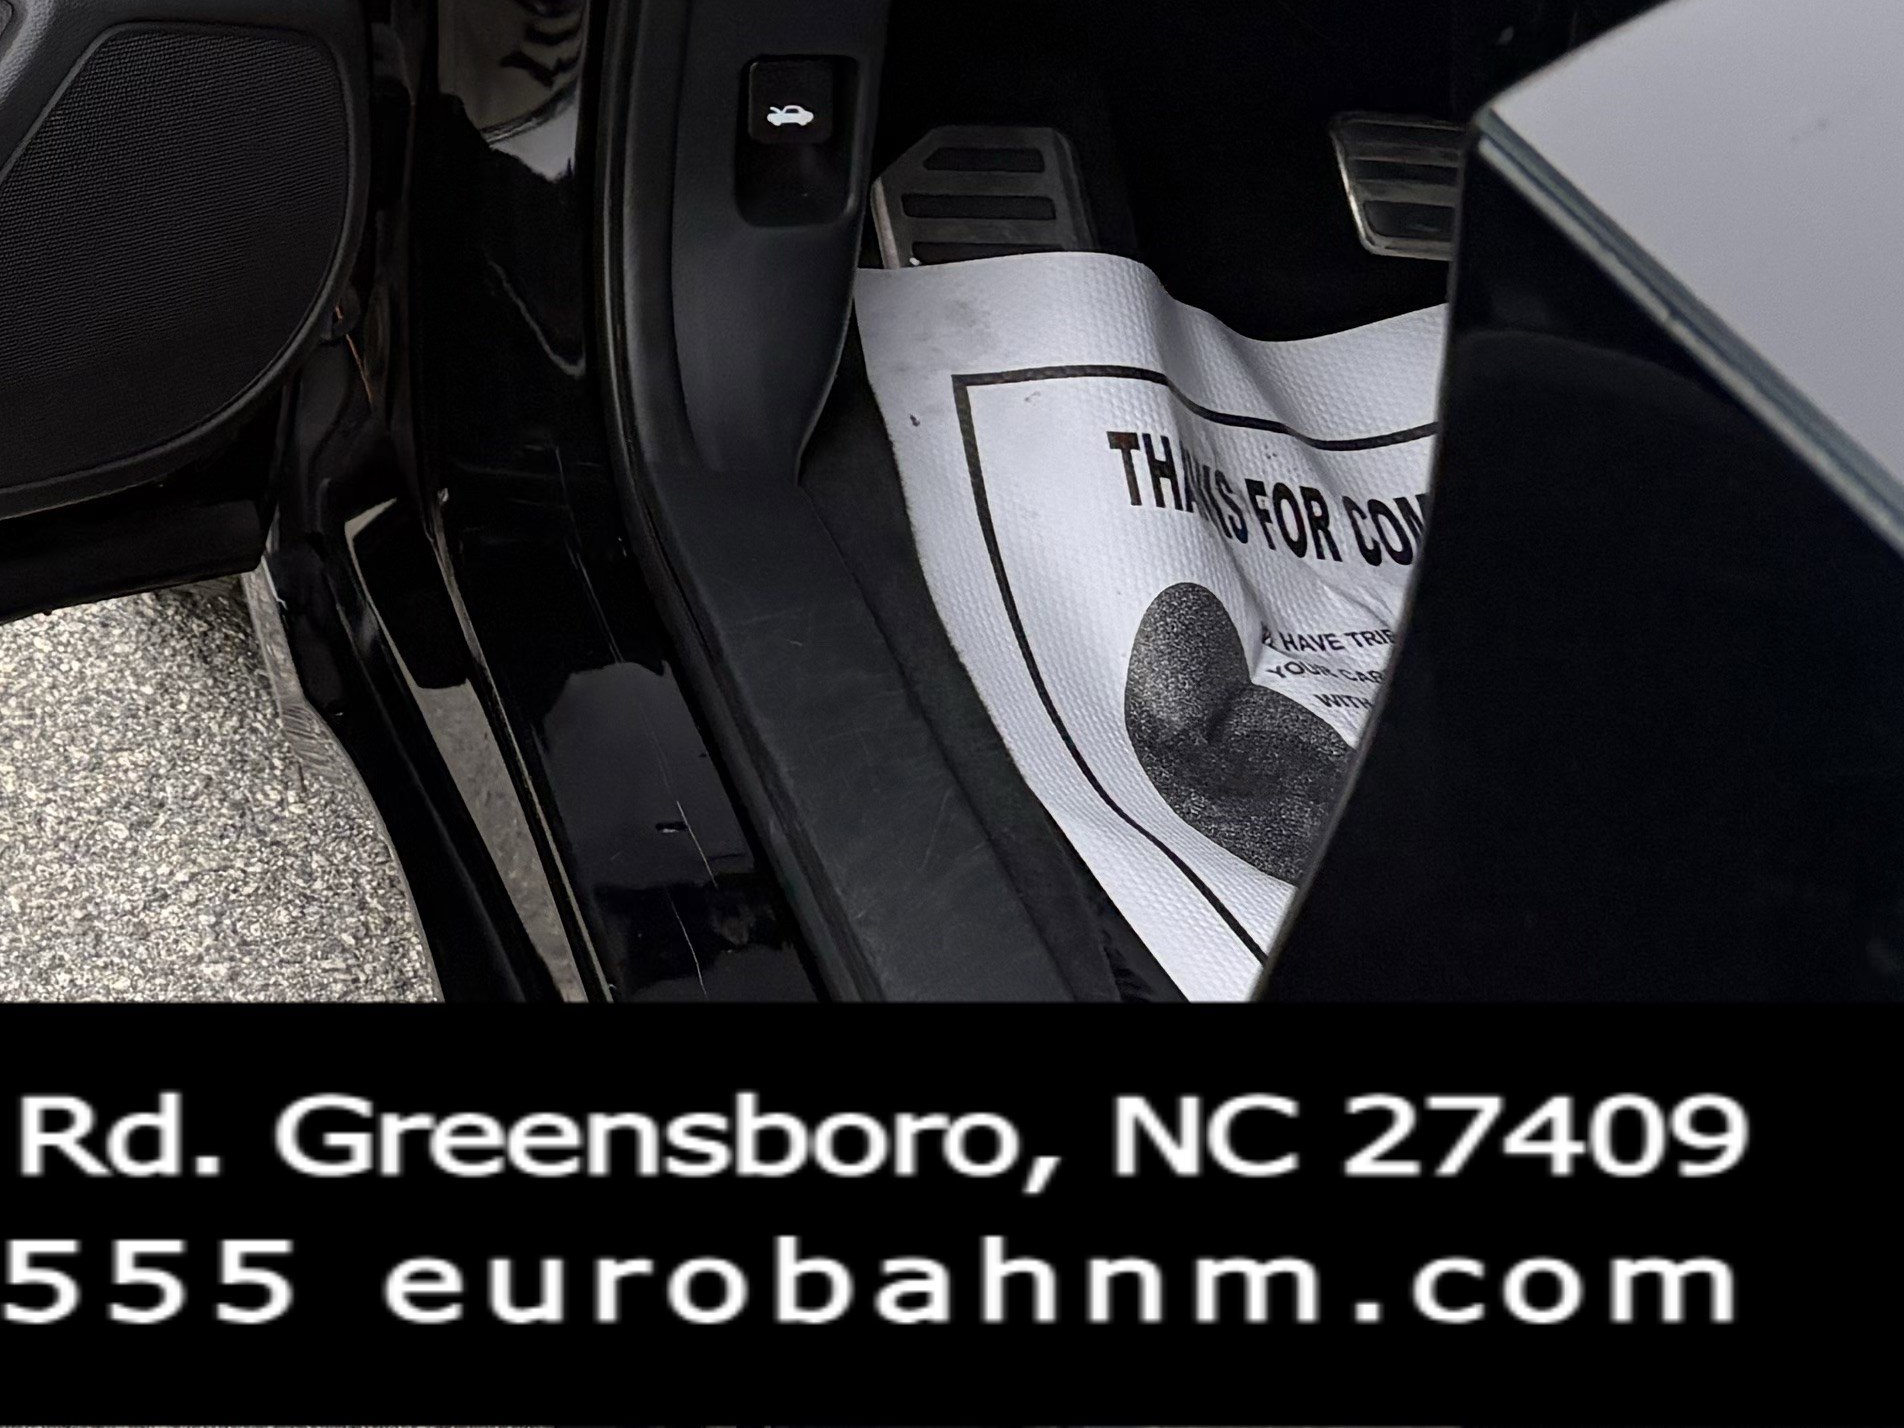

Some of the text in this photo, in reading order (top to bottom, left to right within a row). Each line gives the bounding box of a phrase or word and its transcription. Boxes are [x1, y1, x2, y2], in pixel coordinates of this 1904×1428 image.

[1244, 478, 1343, 563] FOR
[1277, 630, 1346, 653] HAVE
[1265, 660, 1339, 679] YOUR
